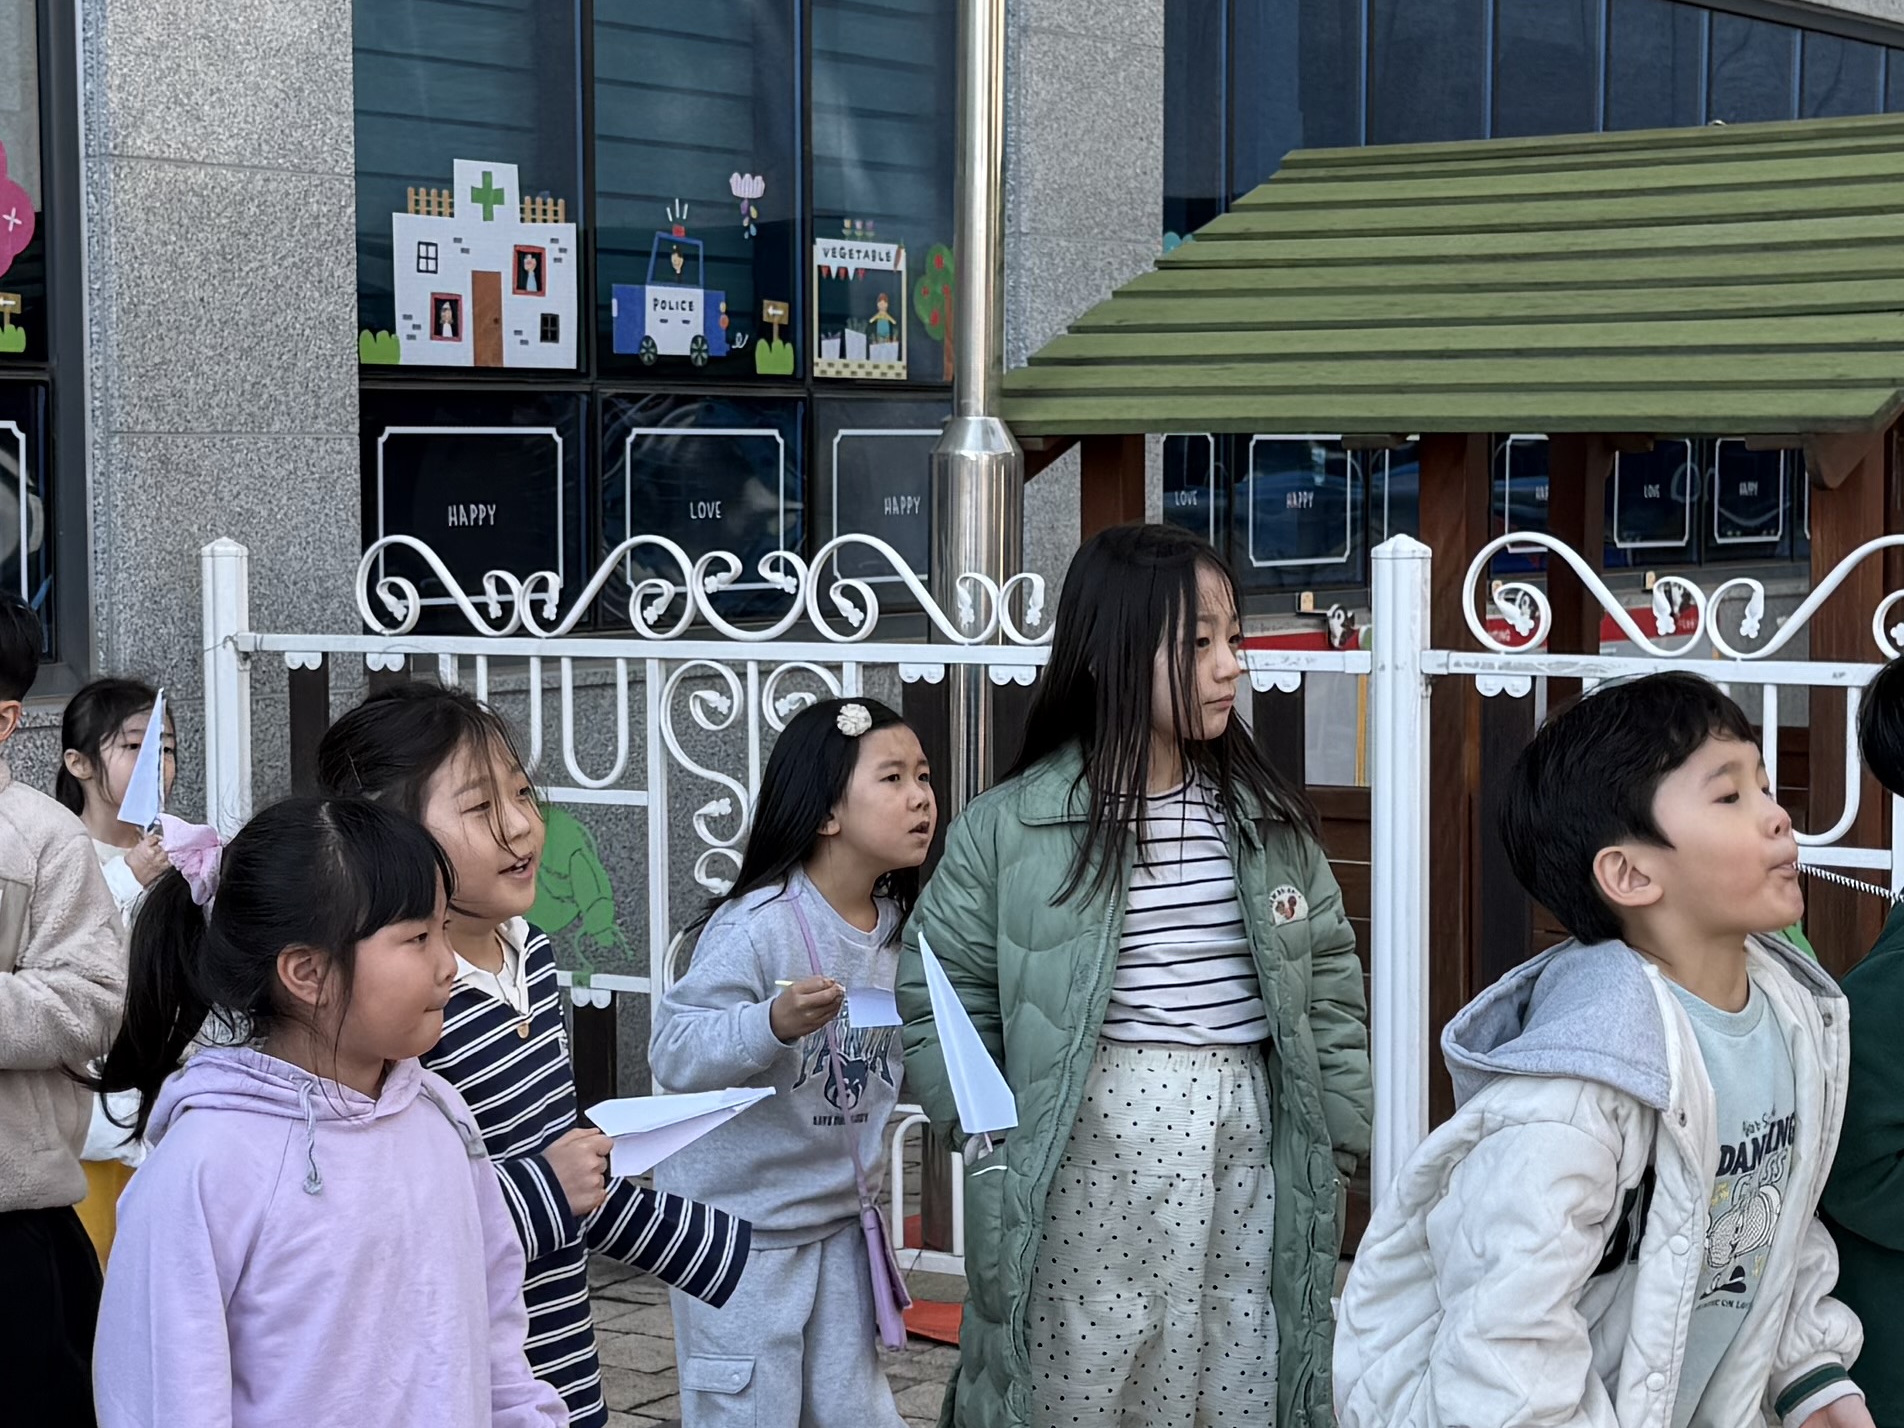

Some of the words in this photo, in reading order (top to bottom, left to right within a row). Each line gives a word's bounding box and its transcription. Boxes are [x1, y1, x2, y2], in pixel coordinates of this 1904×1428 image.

[822, 247, 892, 263] VEGETABLE
[652, 297, 695, 312] POLICE
[883, 495, 922, 516] HAPPY
[1174, 490, 1198, 506] LOVE
[1286, 491, 1315, 509] HAPPY
[447, 503, 497, 527] HAPPY
[689, 500, 723, 520] LOVE
